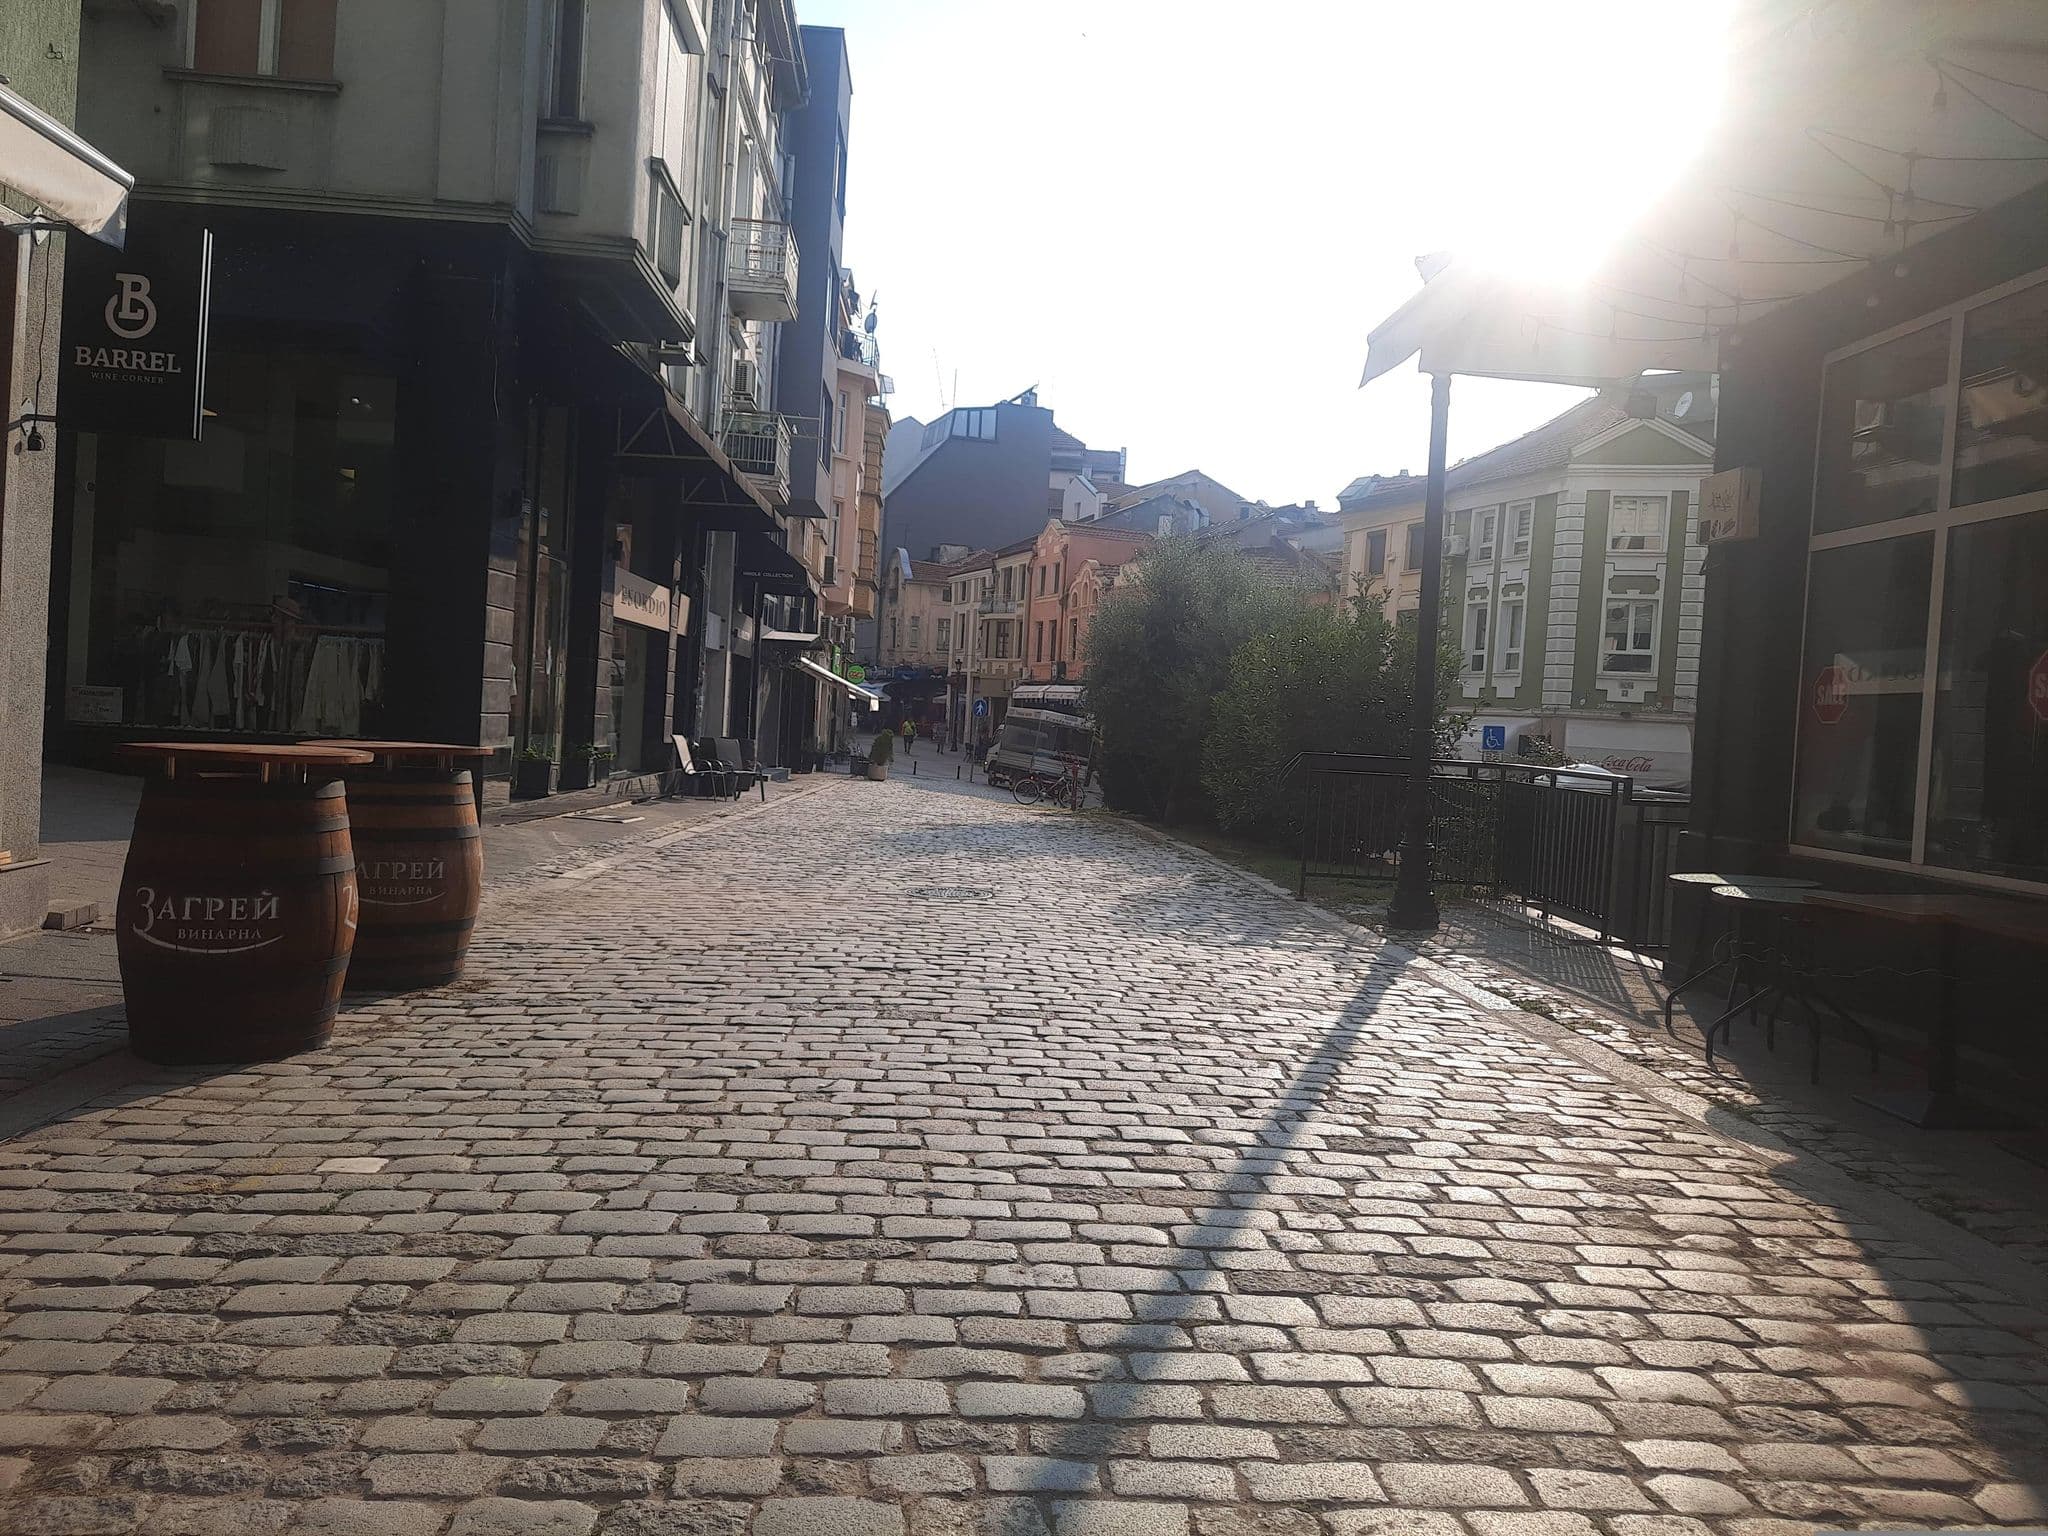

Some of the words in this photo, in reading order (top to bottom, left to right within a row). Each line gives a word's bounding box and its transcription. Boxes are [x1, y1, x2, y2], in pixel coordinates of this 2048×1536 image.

[75, 346, 181, 373] BARREL
[91, 371, 119, 381] WINE
[122, 374, 164, 384] CORNER
[355, 857, 446, 880] АГРЕЙ
[368, 885, 433, 896] ВИНАРНА
[177, 927, 264, 940] ВИНАРНА
